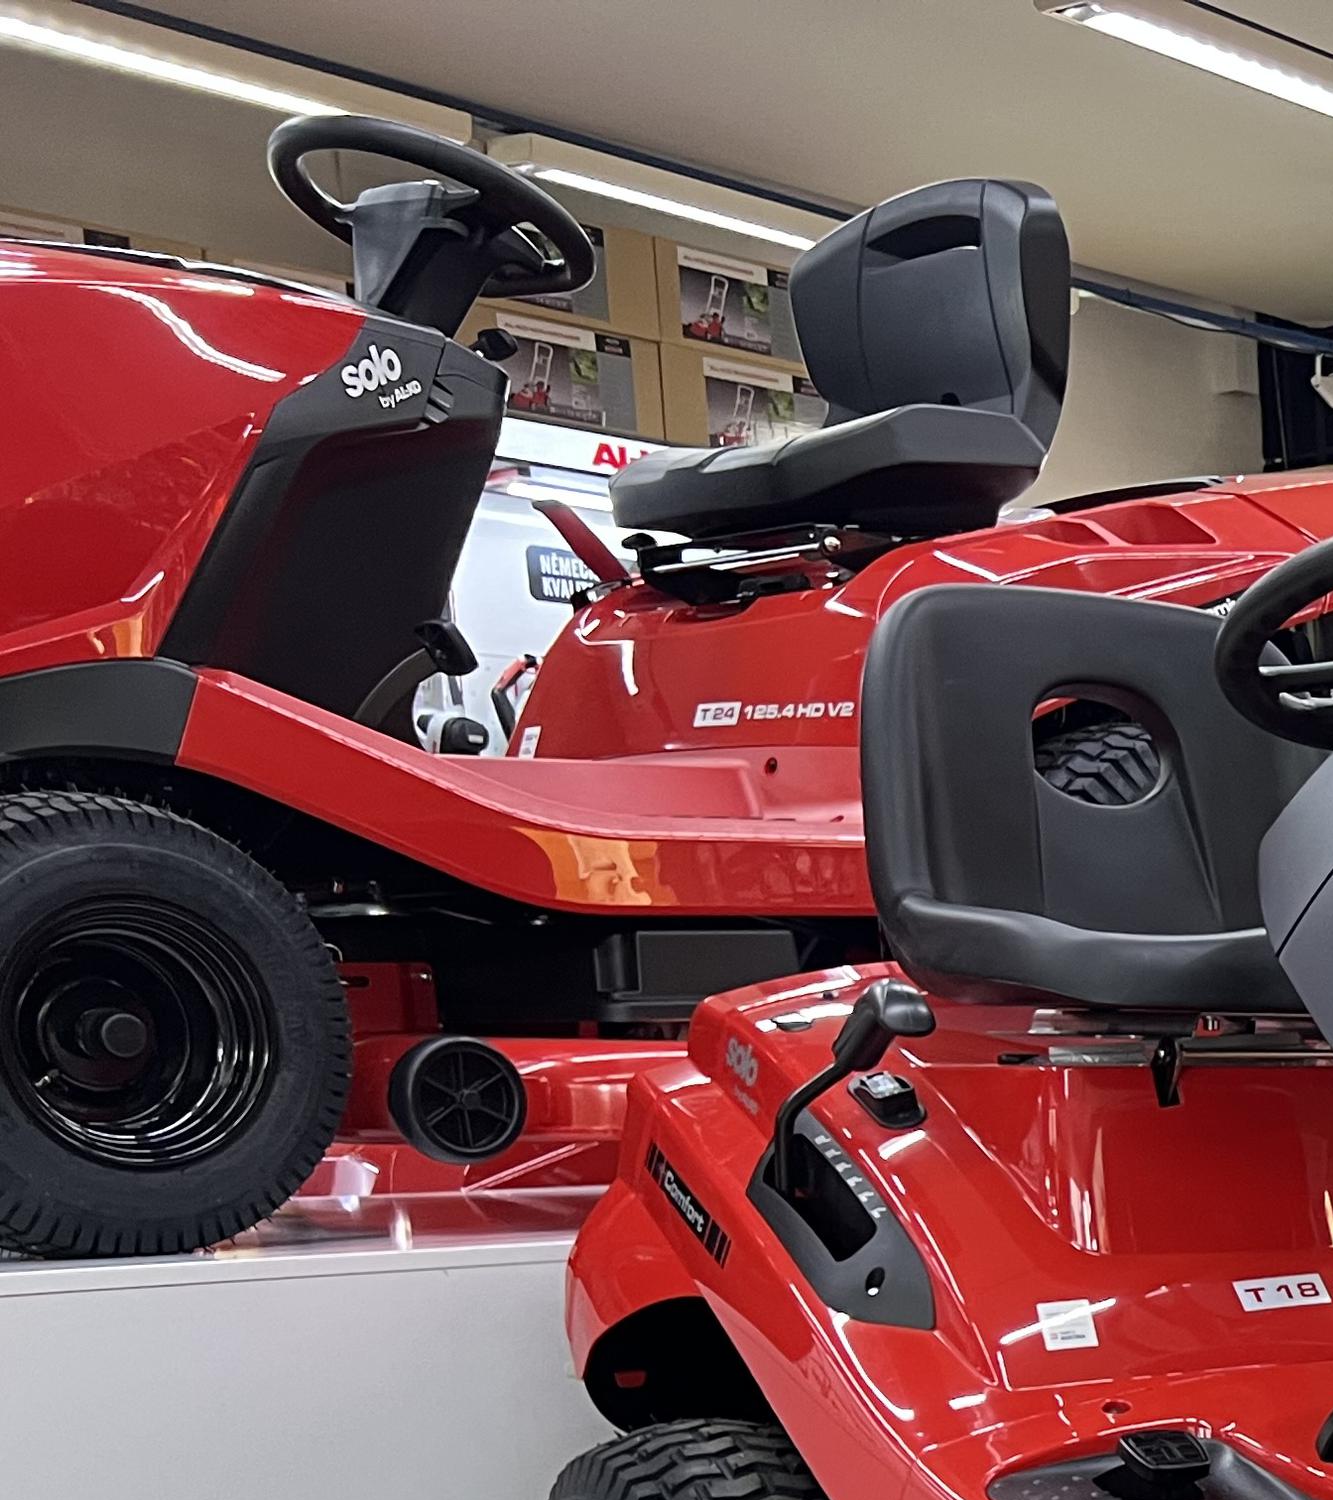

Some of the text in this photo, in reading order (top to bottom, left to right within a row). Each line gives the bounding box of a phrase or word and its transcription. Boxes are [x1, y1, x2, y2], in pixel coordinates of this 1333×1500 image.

[341, 344, 402, 398] solo
[379, 394, 395, 409] by
[796, 703, 825, 718] HD
[827, 701, 855, 717] V2
[664, 1170, 705, 1233] Comfort
